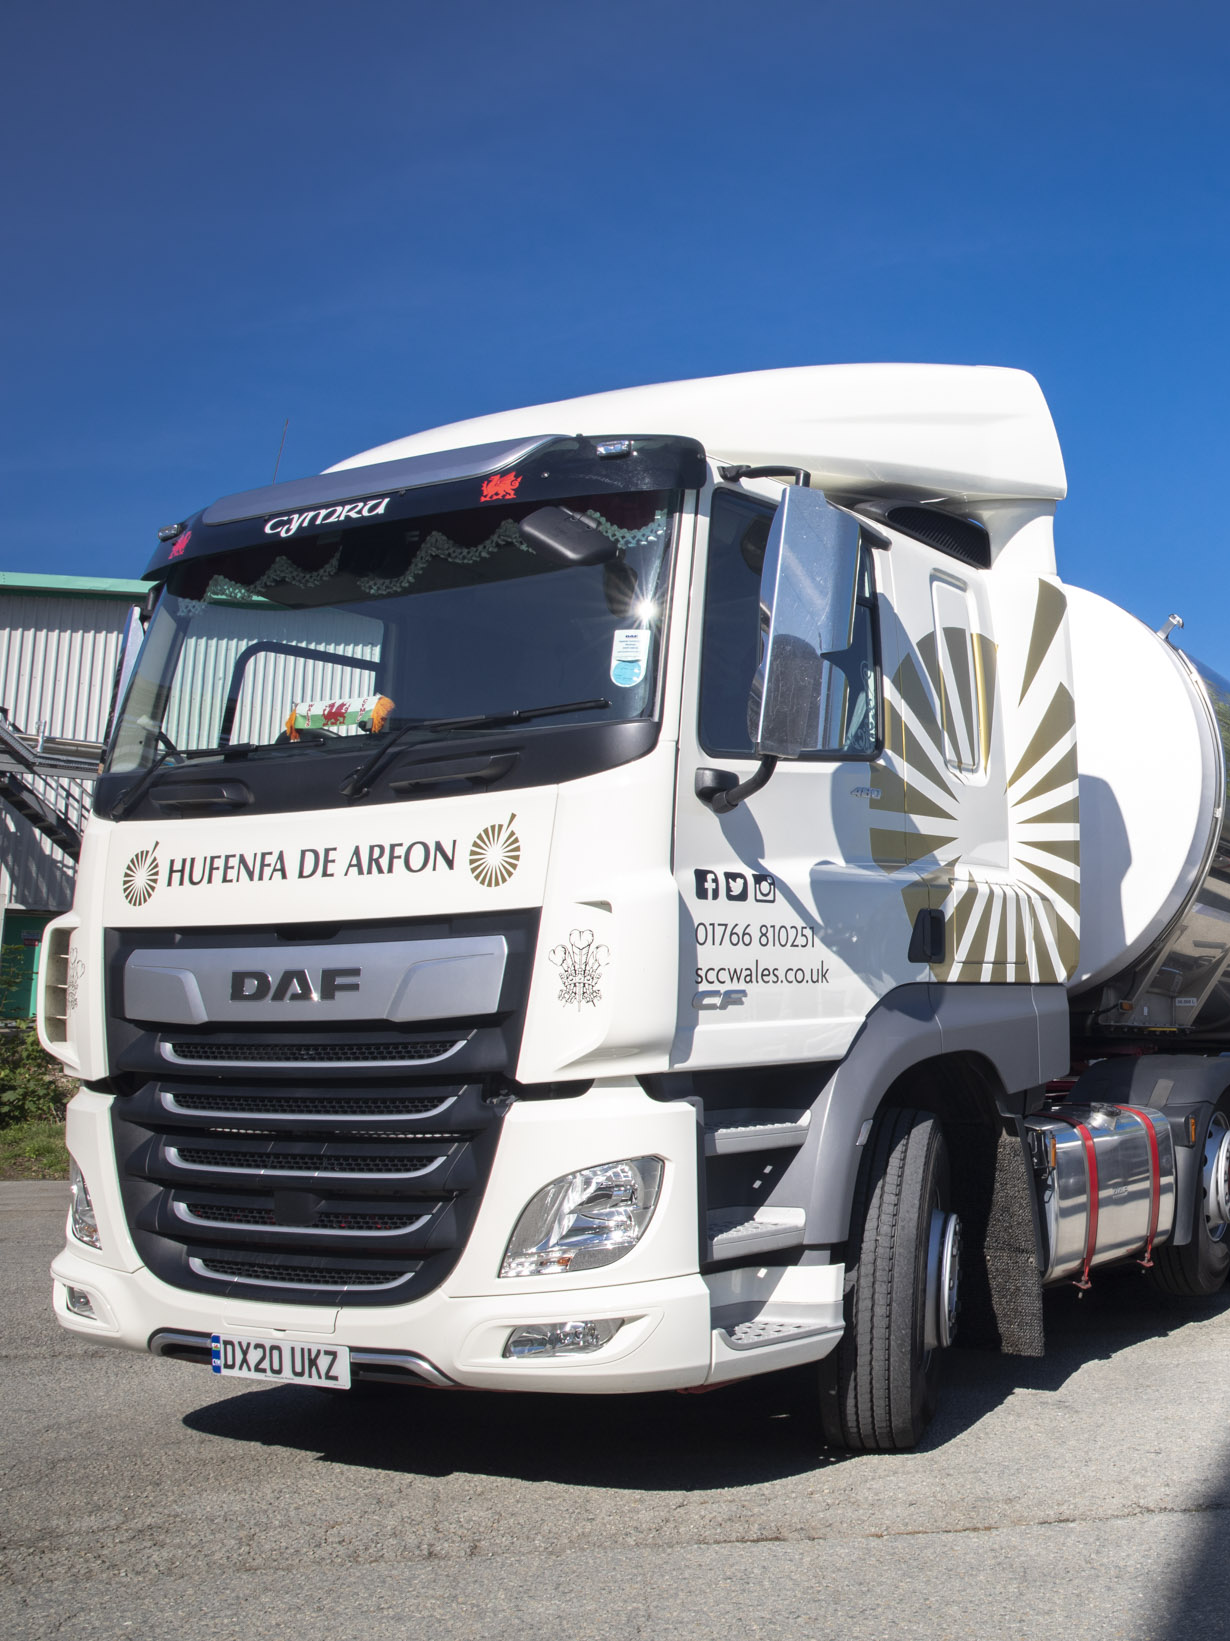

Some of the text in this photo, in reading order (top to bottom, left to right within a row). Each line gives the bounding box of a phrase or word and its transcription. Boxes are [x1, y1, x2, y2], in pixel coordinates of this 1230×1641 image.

[166, 839, 457, 888] HUFENFA DE ARFON
[695, 922, 815, 948] 01766 810251
[230, 967, 362, 1002] DAF
[694, 959, 830, 985] sccwales.co.uk
[692, 989, 748, 1011] CF
[222, 1339, 339, 1381] DX20 UKZ
